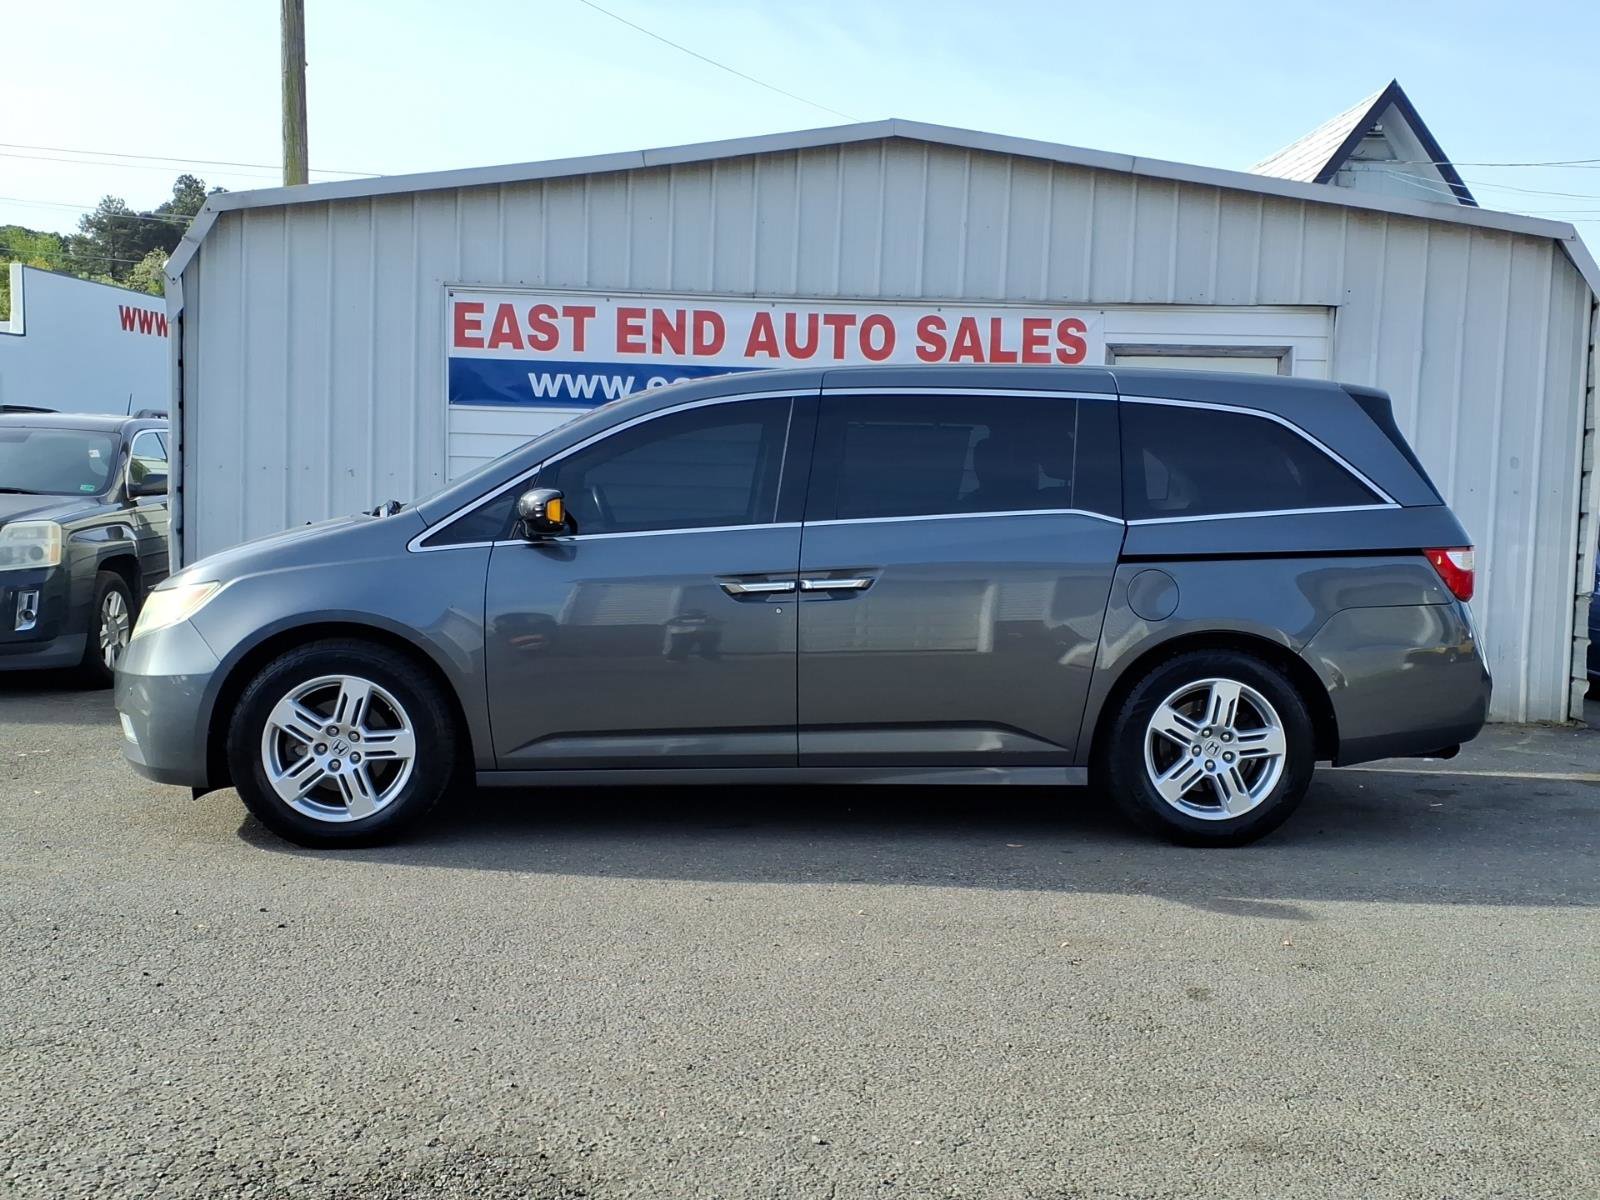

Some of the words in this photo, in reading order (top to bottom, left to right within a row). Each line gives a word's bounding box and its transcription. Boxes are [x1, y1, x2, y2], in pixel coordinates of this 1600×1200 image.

[453, 302, 596, 352] EAST
[616, 307, 726, 356] END
[744, 311, 896, 361] AUTO
[915, 315, 1088, 365] SALES
